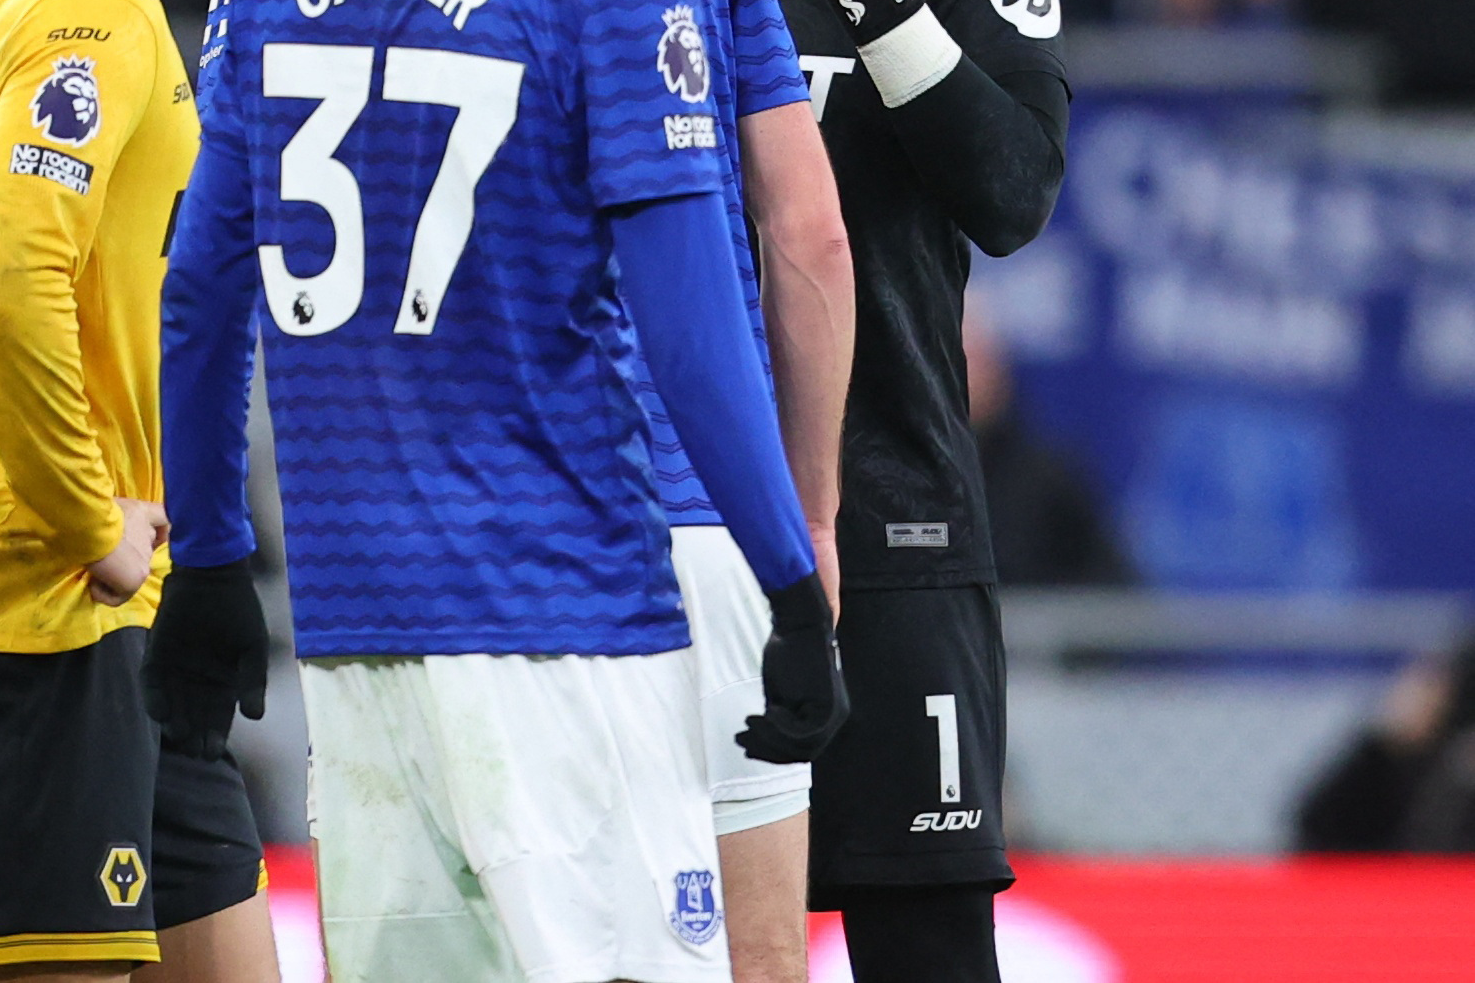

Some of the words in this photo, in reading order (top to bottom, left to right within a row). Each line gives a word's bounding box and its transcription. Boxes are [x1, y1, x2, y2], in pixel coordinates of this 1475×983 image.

[46, 26, 112, 43] SUDU
[664, 114, 692, 133] No
[9, 157, 39, 174] for
[11, 144, 41, 162] No
[41, 150, 87, 180] room
[257, 42, 526, 337] 37
[925, 693, 961, 803] 1
[909, 809, 982, 832] SUDU
